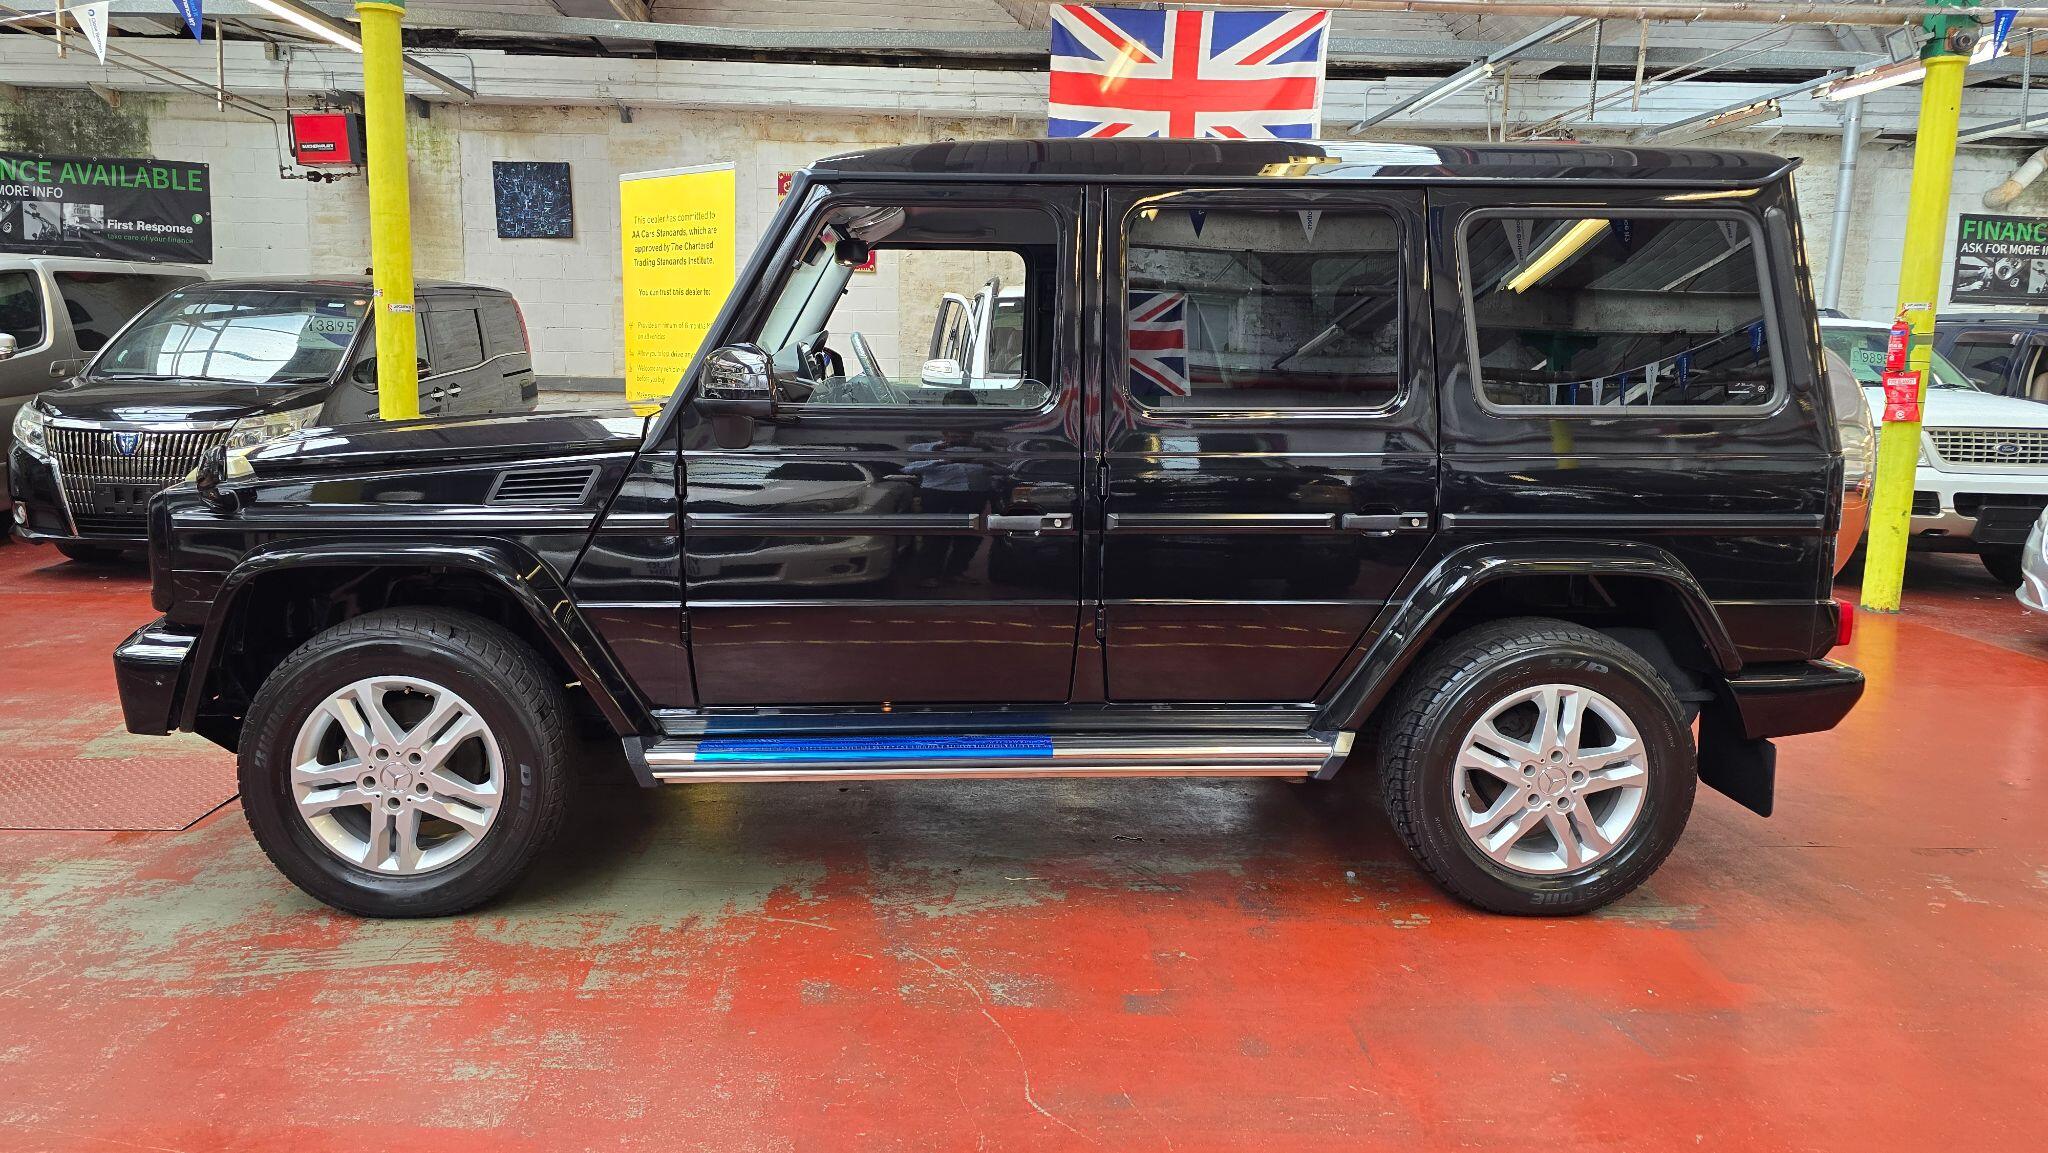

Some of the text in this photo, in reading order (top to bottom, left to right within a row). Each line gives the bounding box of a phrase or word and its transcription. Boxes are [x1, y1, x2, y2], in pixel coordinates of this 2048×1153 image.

[59, 162, 203, 192] AVAILABLE
[33, 186, 63, 198] INFO
[634, 215, 646, 224] This
[647, 214, 665, 224] dealer
[107, 219, 193, 234] First Response
[632, 230, 640, 239] AA
[641, 229, 655, 238] Cars
[689, 226, 707, 236] which
[707, 226, 717, 235] are
[1962, 219, 2048, 243] FINANC
[149, 235, 166, 243] your
[167, 236, 194, 245] finance
[634, 240, 714, 254] approved by The Chartered
[1960, 243, 1983, 253] ASK
[1985, 243, 2008, 254] FOR
[2009, 244, 2041, 256] MORE
[633, 258, 656, 268] Trading
[656, 257, 687, 266] Standards
[638, 288, 648, 297] You
[659, 288, 672, 296] trust
[672, 287, 685, 296] this
[685, 287, 703, 296] dealer
